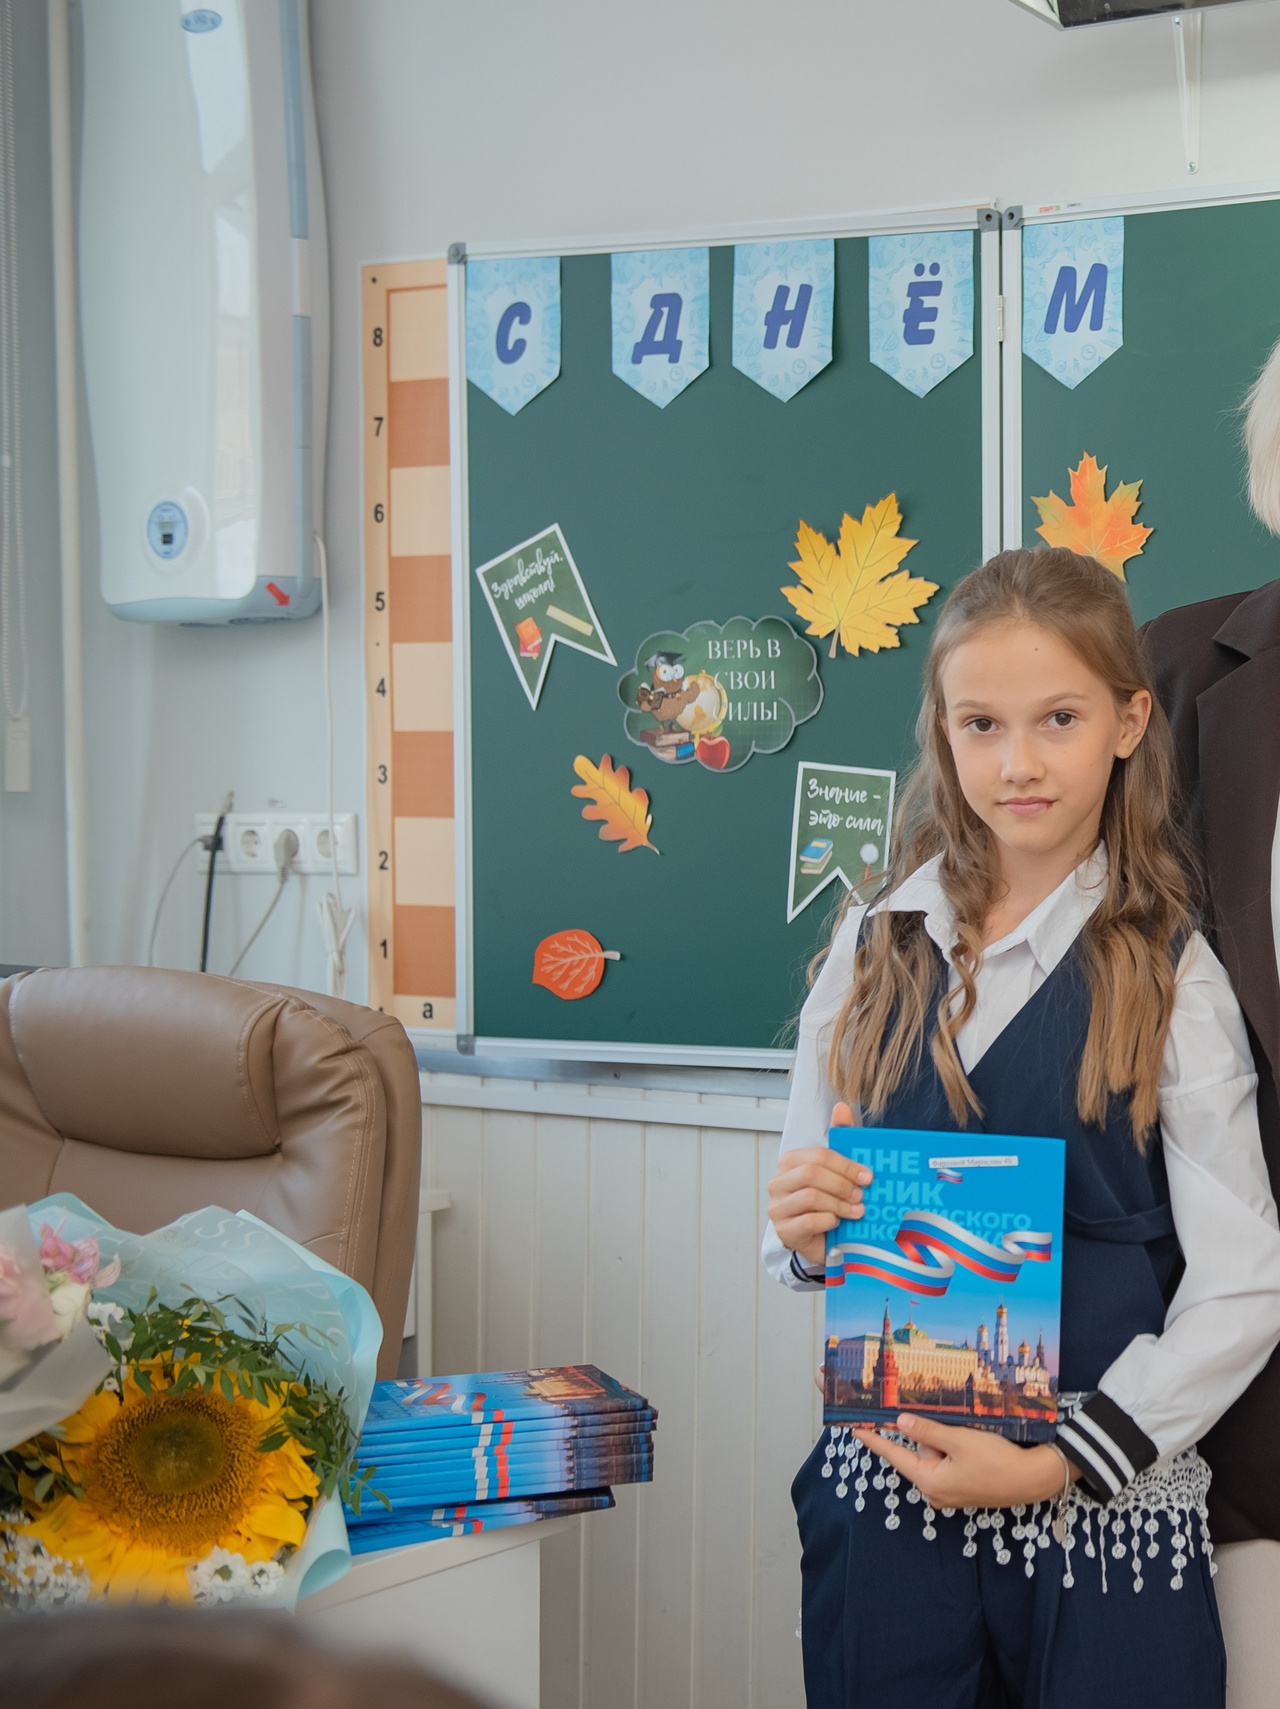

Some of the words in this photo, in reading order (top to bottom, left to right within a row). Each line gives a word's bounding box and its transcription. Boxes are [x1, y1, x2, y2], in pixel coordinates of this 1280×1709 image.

[372, 327, 384, 347] 8
[495, 301, 532, 365] С
[373, 416, 384, 437] 7
[374, 503, 385, 523] 6
[375, 592, 386, 611] 5
[707, 639, 761, 659] ВЕРЬ
[767, 638, 781, 659] В
[376, 677, 387, 697] 4
[714, 670, 776, 690] СВОИ
[377, 764, 388, 783] 3
[807, 778, 868, 804] Знание
[808, 809, 843, 829] это
[845, 815, 884, 836] сила
[379, 851, 389, 870] 2
[379, 939, 388, 959] 1
[422, 1003, 434, 1019] a
[862, 1180, 945, 1207] НИК
